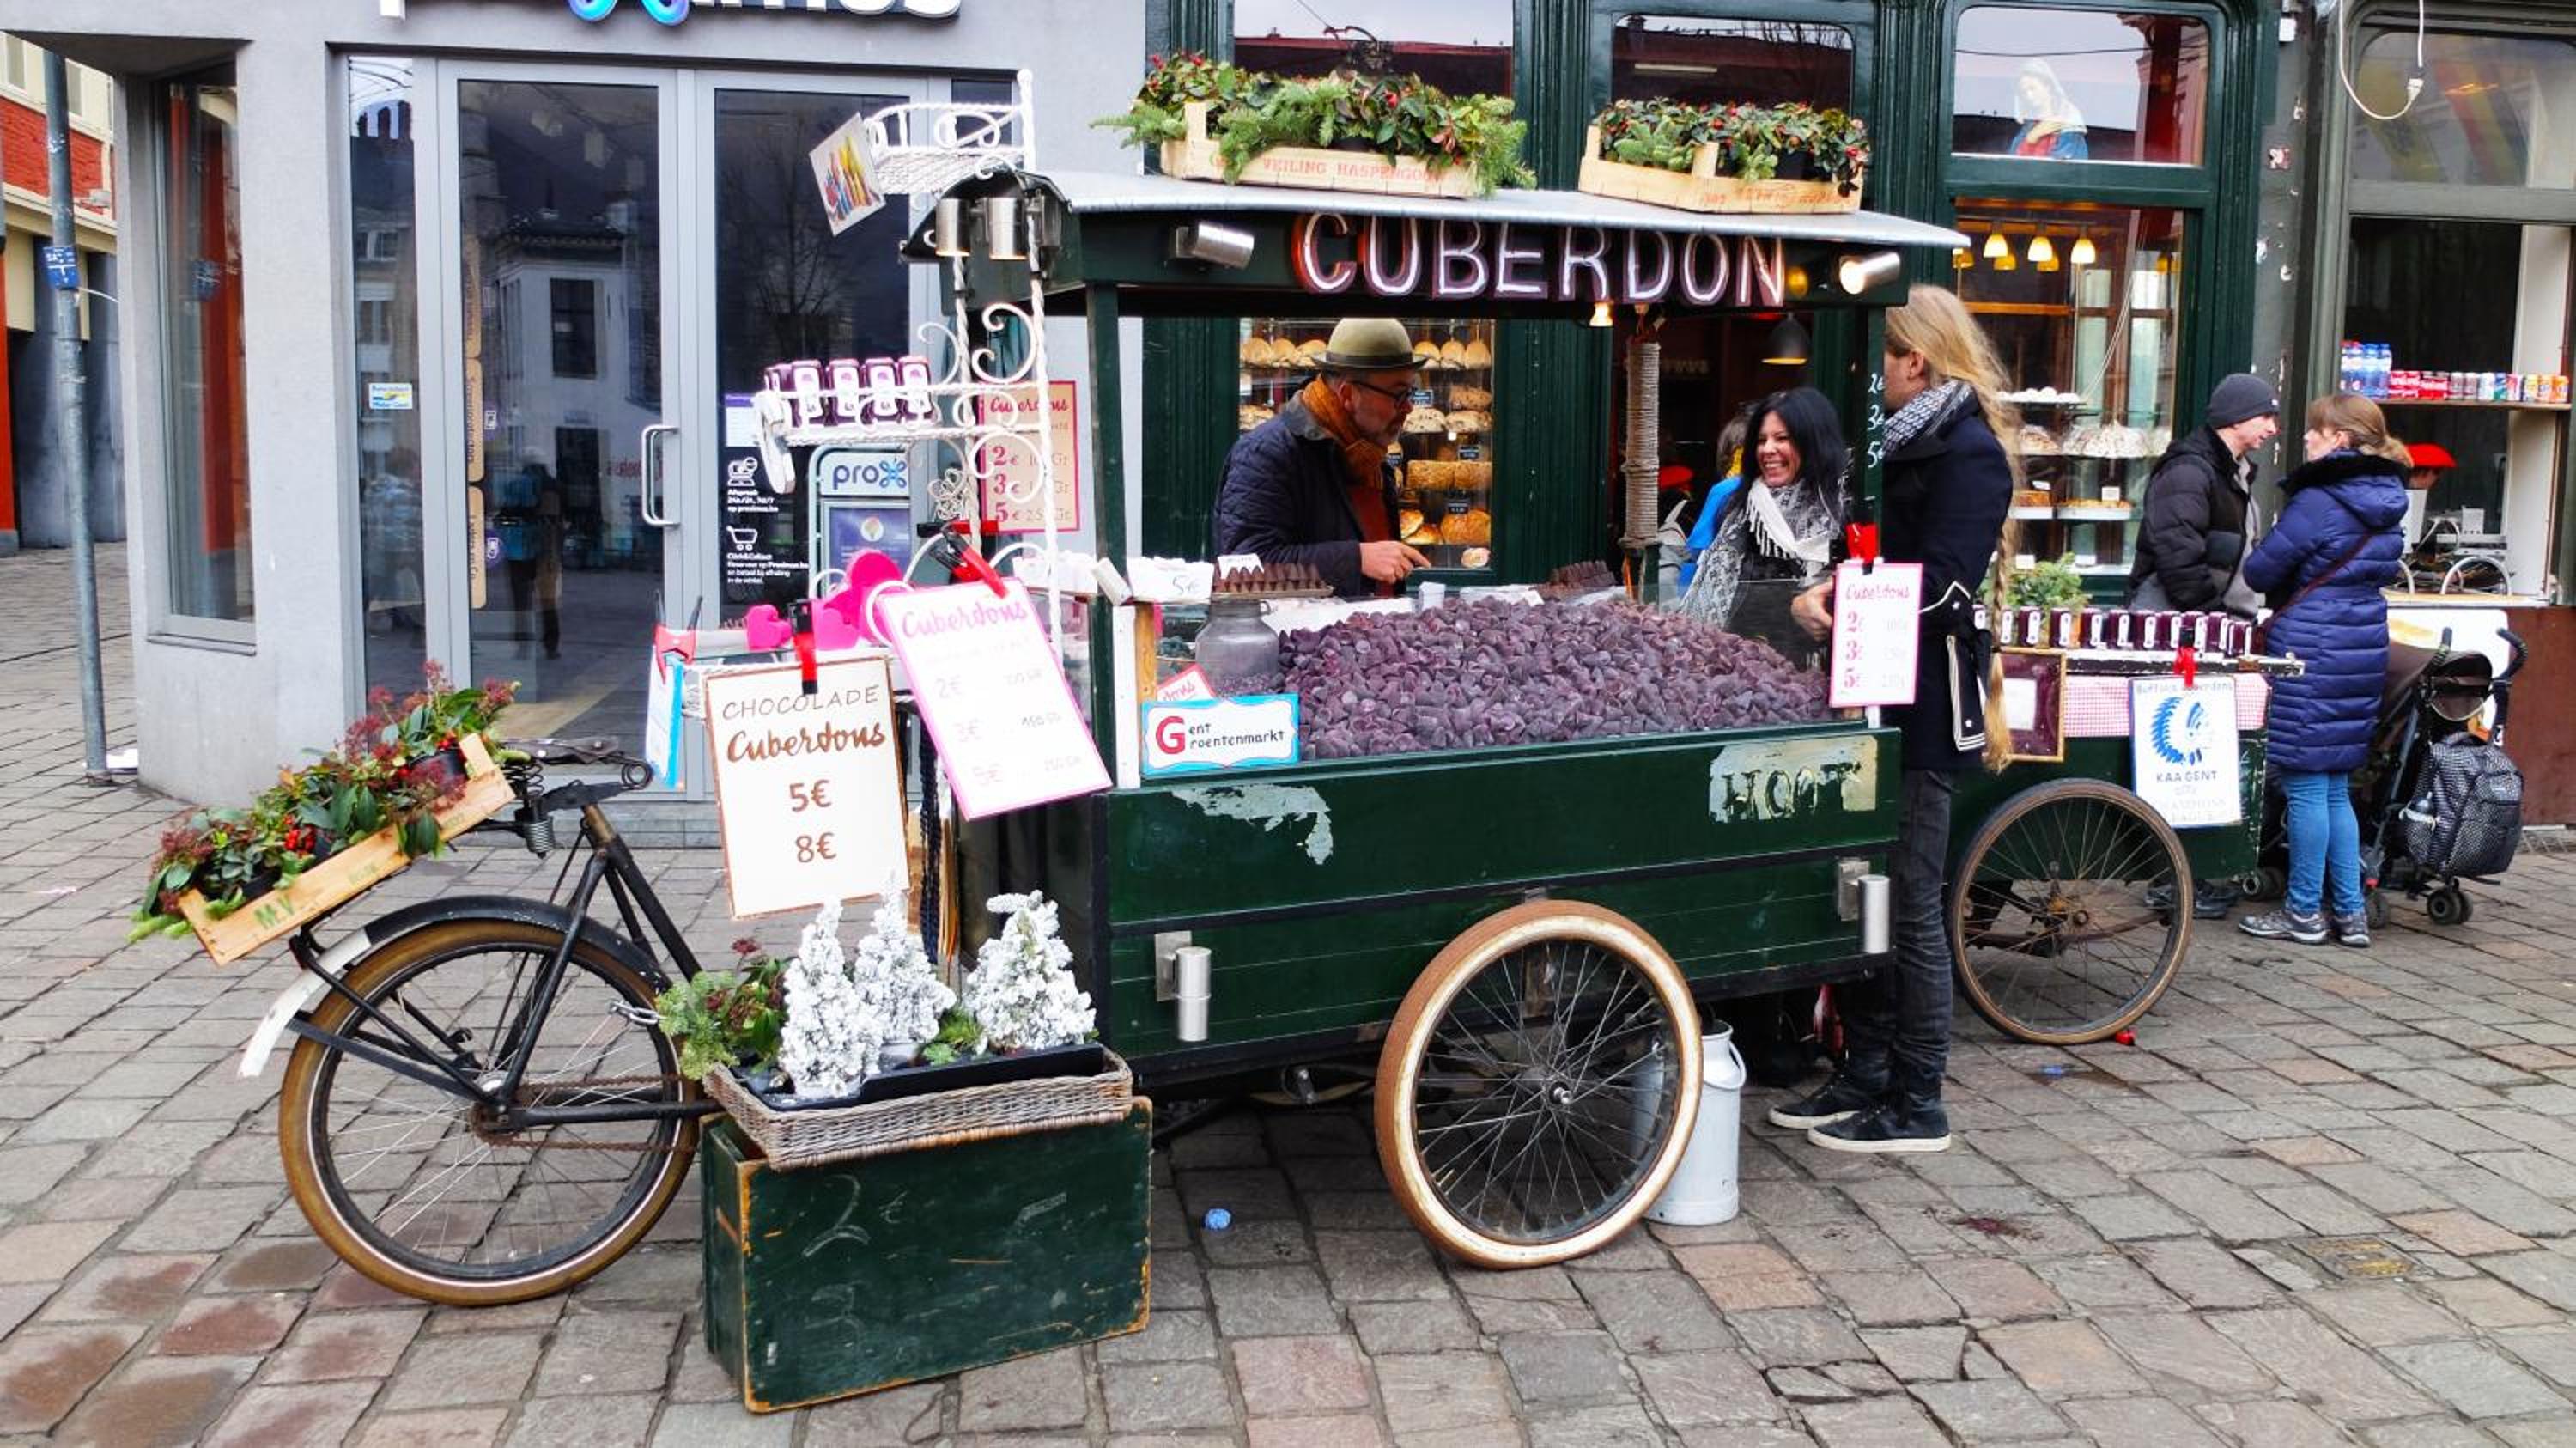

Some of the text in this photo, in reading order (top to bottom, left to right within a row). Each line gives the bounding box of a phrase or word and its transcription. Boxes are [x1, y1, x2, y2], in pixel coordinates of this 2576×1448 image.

[1292, 212, 1785, 307] CUBERDON
[902, 600, 1028, 639] Cuberdons
[722, 684, 880, 721] CHOCOLADE
[726, 721, 886, 763] Cuberdons
[2156, 770, 2218, 783] KAA GENT
[788, 779, 833, 813] 5€
[795, 831, 837, 864] 8€
